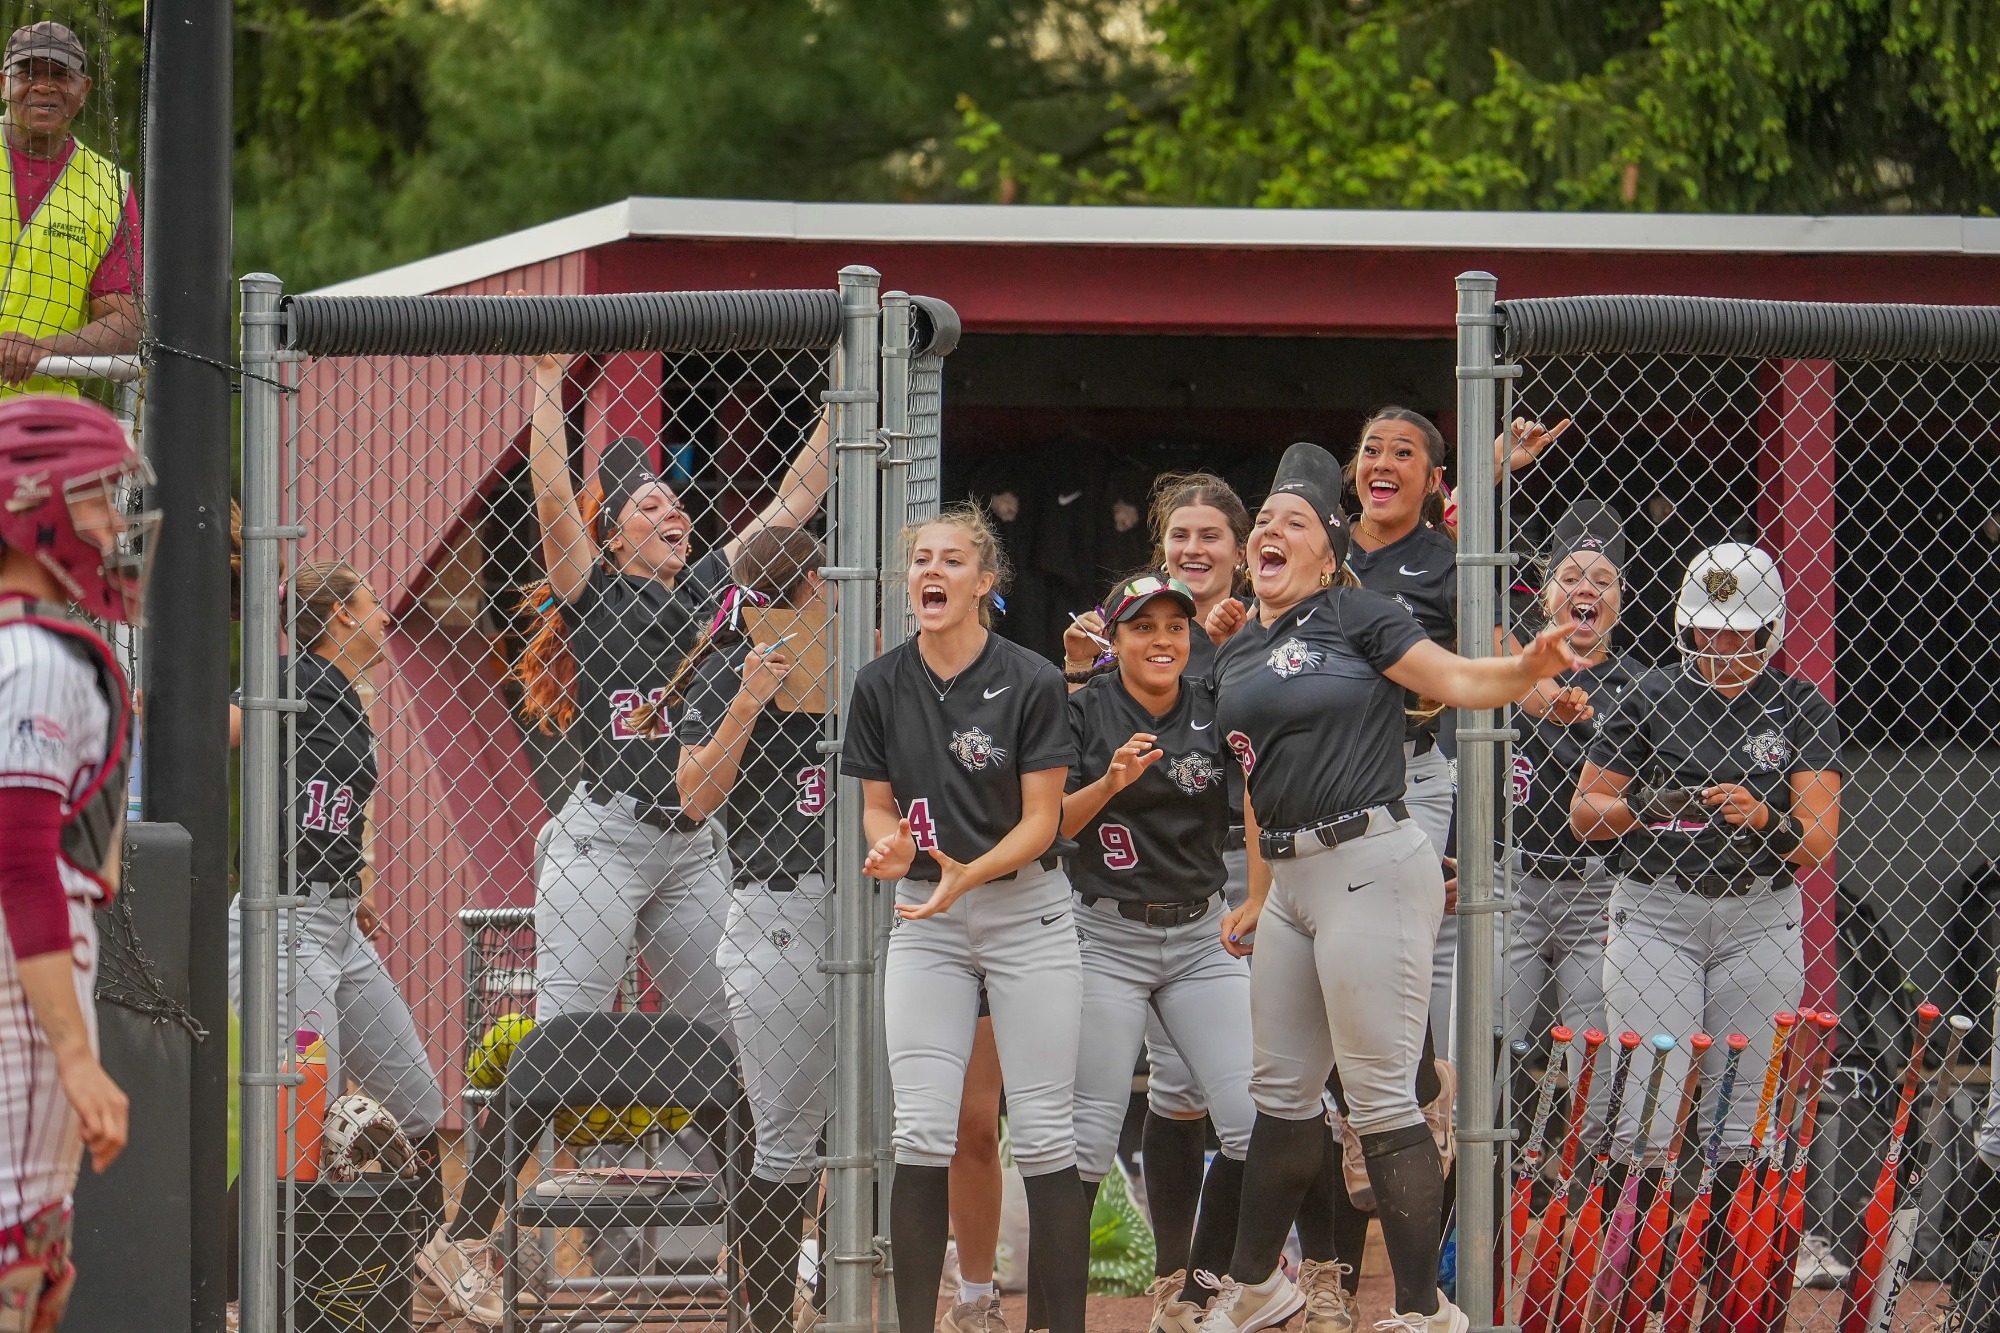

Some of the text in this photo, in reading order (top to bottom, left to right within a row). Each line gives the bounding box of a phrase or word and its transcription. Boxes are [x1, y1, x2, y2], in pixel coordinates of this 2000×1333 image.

[609, 687, 672, 740] 21
[302, 779, 354, 836] 12
[796, 765, 826, 817] 3
[1098, 822, 1139, 871] 9
